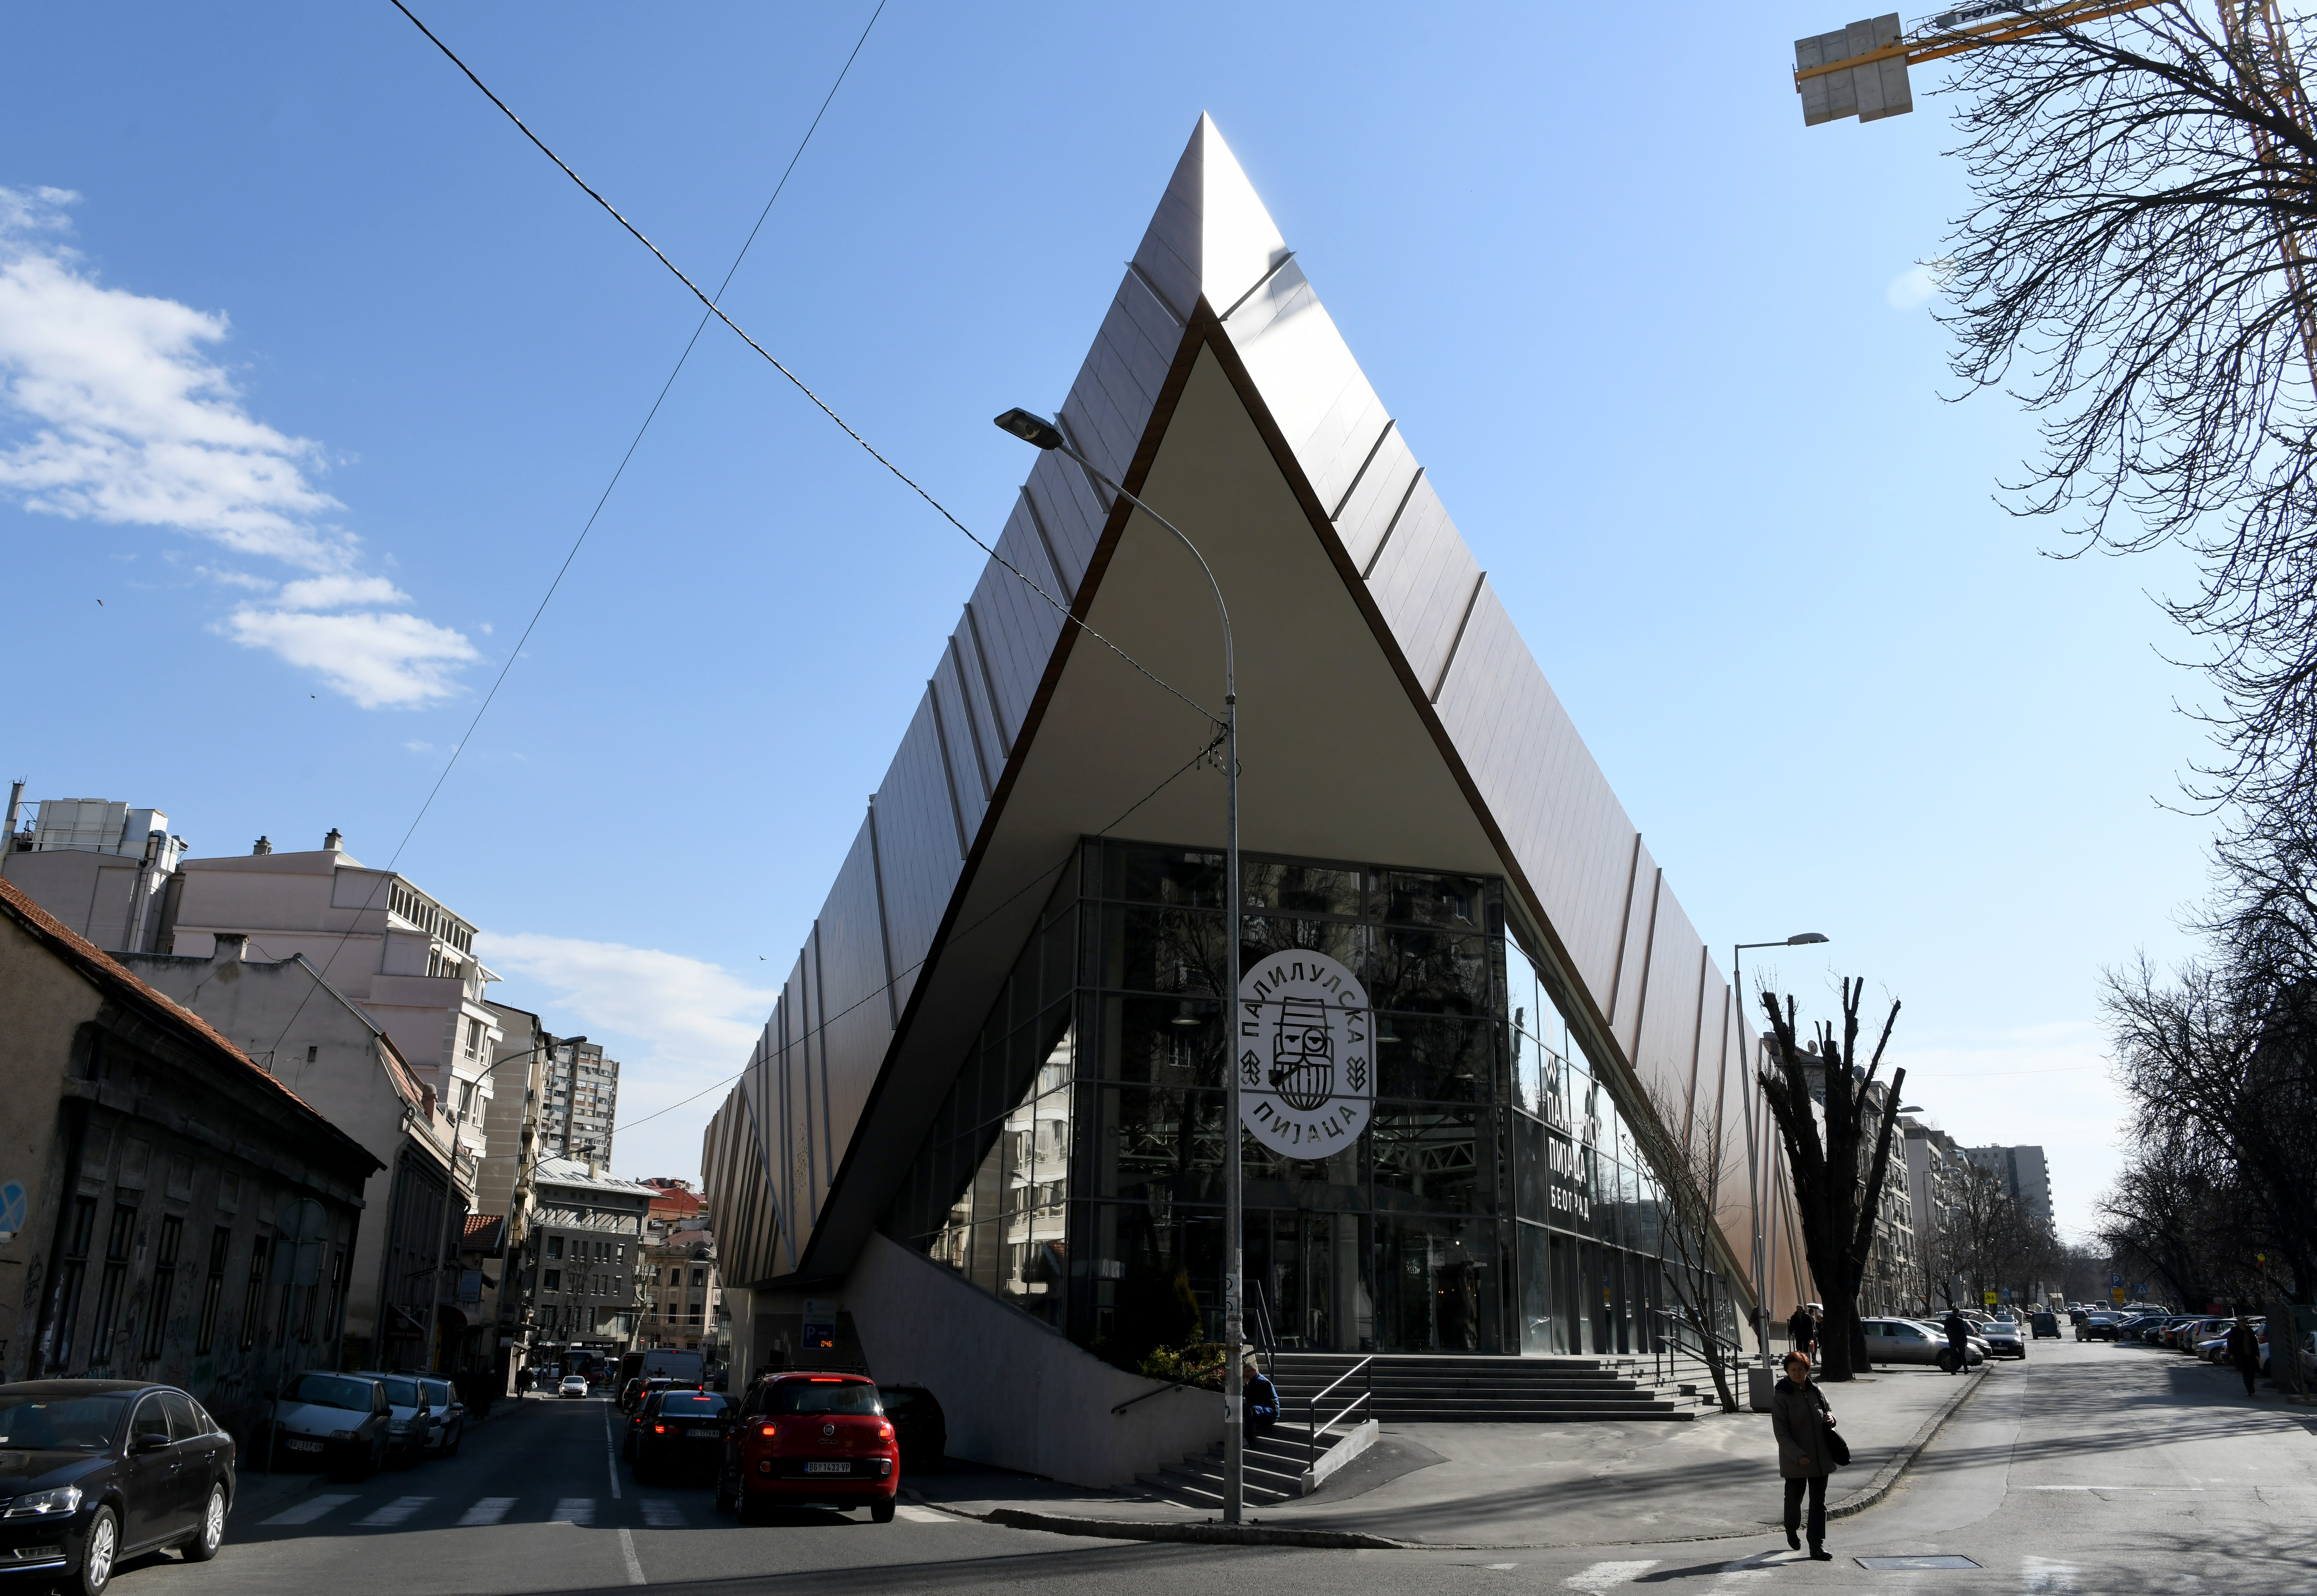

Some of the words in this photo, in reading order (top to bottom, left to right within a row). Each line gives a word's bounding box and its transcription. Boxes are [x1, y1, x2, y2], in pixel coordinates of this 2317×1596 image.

[1242, 962, 1364, 1044] ПАЛИЛУЛСКА
[1253, 1101, 1357, 1145] ПИЈАЦА
[1549, 1136, 1586, 1187] ПИЈАЦА
[1551, 1185, 1589, 1222] БЕОГРАД
[807, 1326, 816, 1340] P
